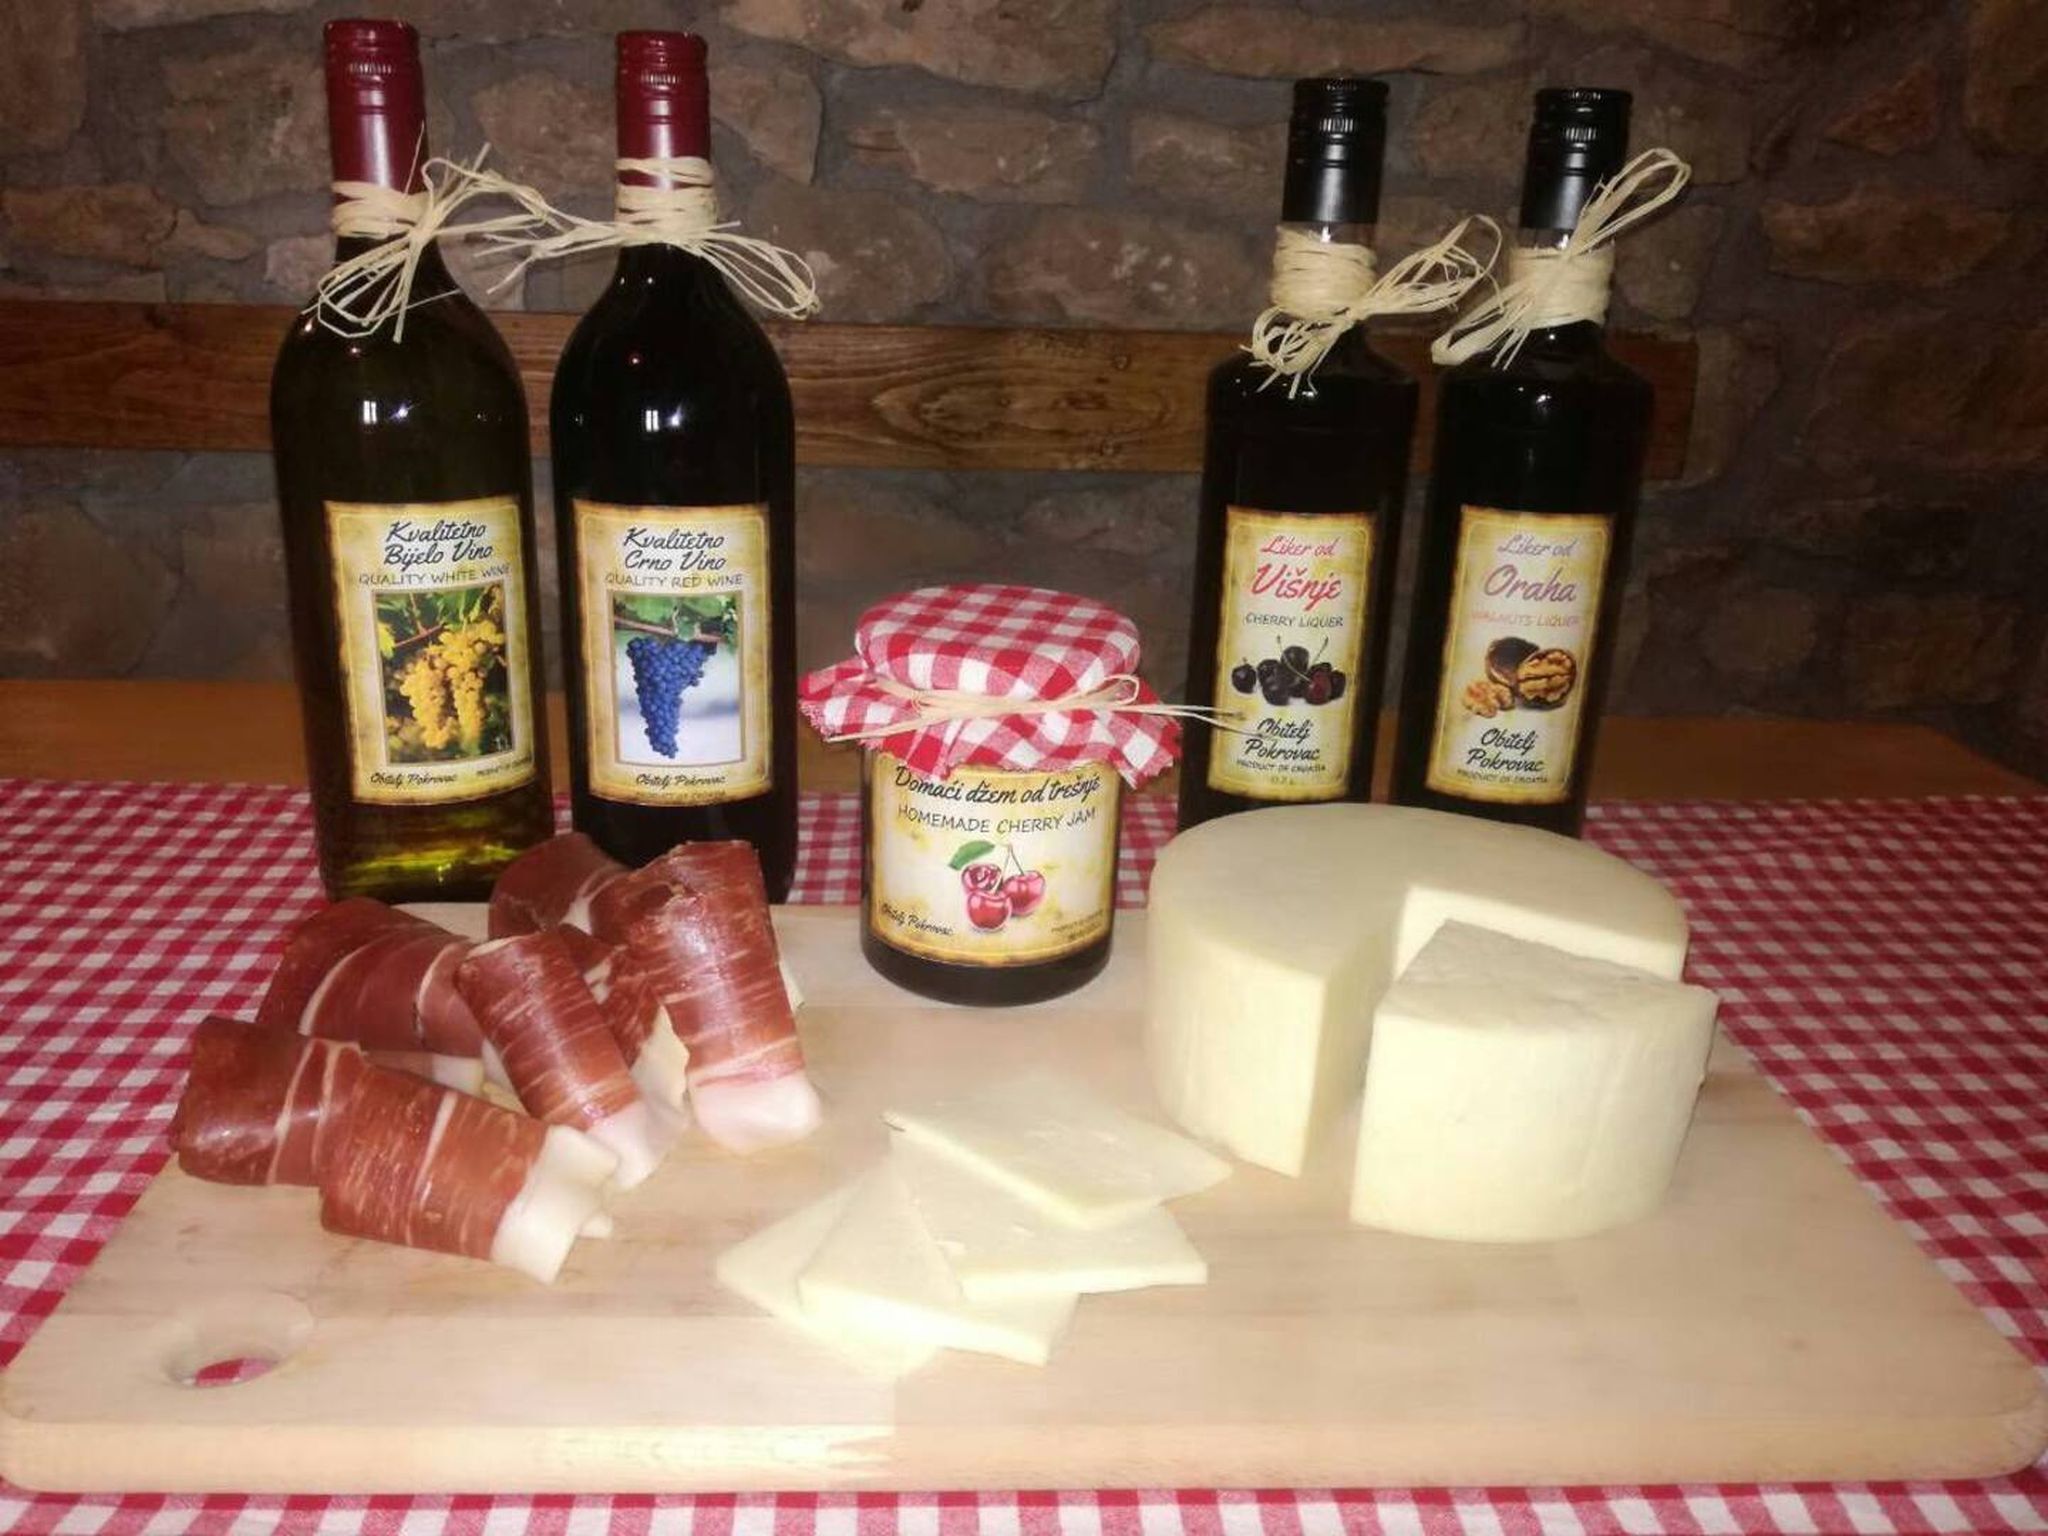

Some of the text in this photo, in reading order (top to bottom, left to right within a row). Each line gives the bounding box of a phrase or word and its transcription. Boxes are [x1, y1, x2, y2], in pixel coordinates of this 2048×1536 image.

[386, 519, 487, 543] Kvalitetno
[624, 527, 725, 550] Kvalitetno
[384, 540, 493, 572] Bijelo Vino
[1260, 535, 1340, 556] Liker od
[1498, 534, 1577, 557] Liker od
[624, 551, 727, 571] Crno Vino
[359, 563, 511, 585] QUALITY WHITE WINE
[605, 571, 743, 588] QUALITY RED WINE
[1484, 563, 1577, 601] Oraha
[1251, 563, 1343, 611] Višnje
[1245, 612, 1344, 628] CHERRY LIQUER
[1257, 718, 1313, 744] Obitelj
[1481, 727, 1539, 755] Obitelj
[1246, 738, 1320, 760] Pokrovac
[1466, 748, 1545, 772] Pokrovac
[895, 766, 1101, 804] Domaći džem od trešnje
[898, 804, 1098, 834] HOMEMADE CHERRY JAM
